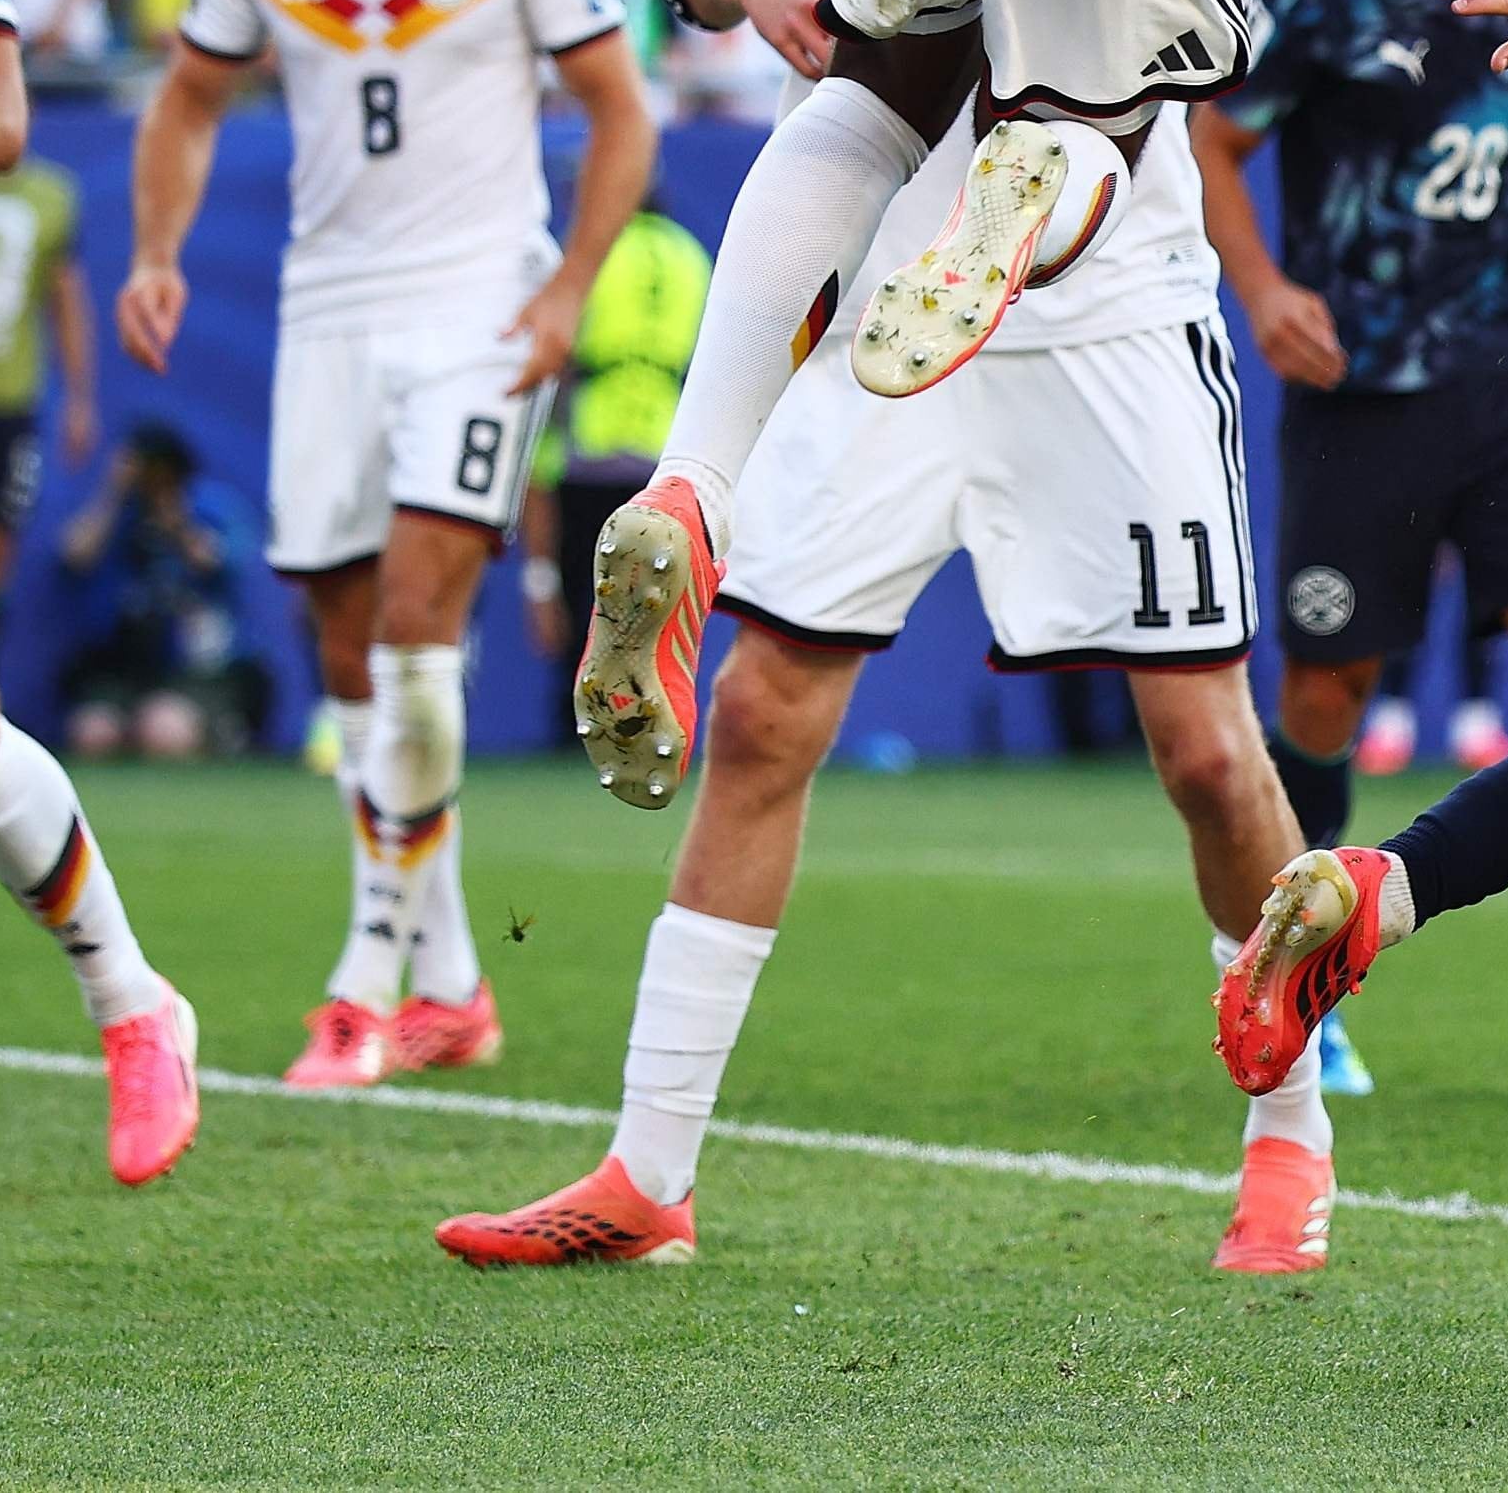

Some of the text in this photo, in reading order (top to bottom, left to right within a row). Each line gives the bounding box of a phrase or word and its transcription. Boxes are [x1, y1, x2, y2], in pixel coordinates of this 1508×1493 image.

[359, 75, 402, 157] 8
[456, 415, 502, 496] 8
[1129, 520, 1226, 628] 11
